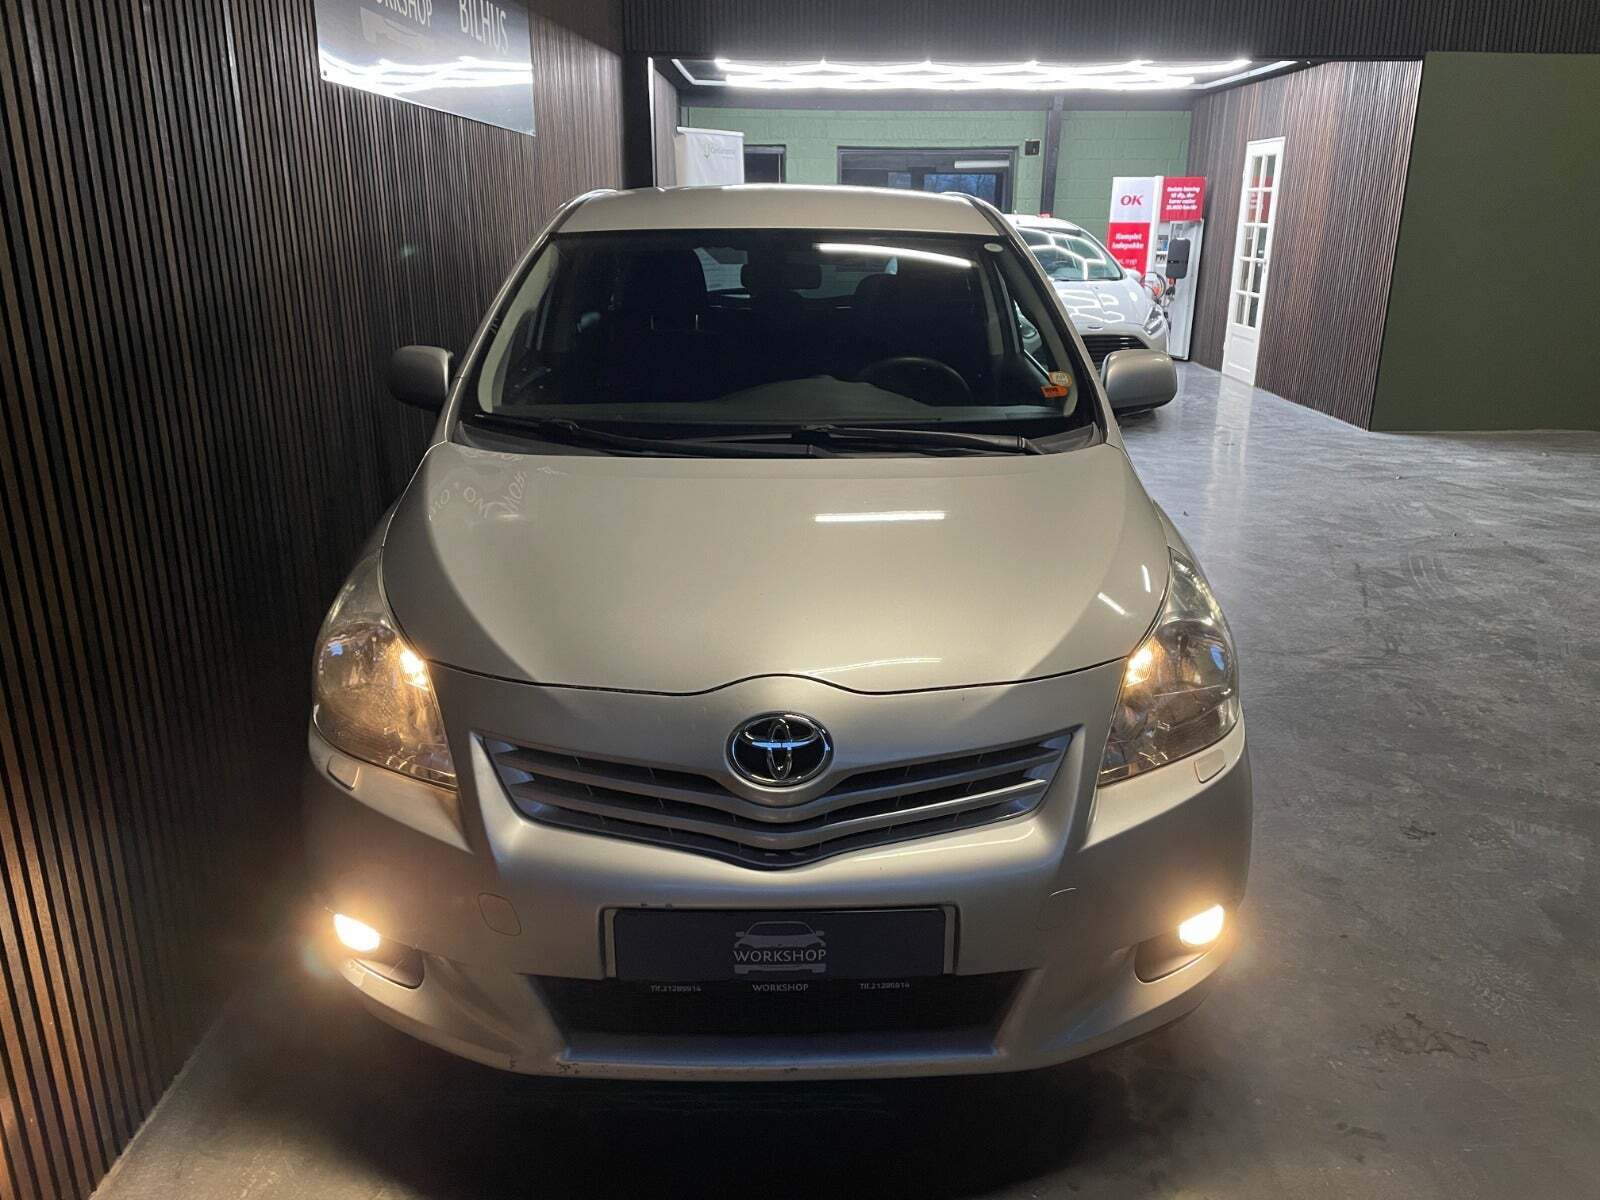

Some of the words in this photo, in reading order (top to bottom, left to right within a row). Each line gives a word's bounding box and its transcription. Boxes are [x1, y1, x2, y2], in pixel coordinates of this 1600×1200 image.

[459, 0, 509, 55] BILHUS
[1120, 194, 1144, 206] OK
[733, 949, 827, 962] WORKSHOP
[752, 983, 809, 992] WORKSHOP
